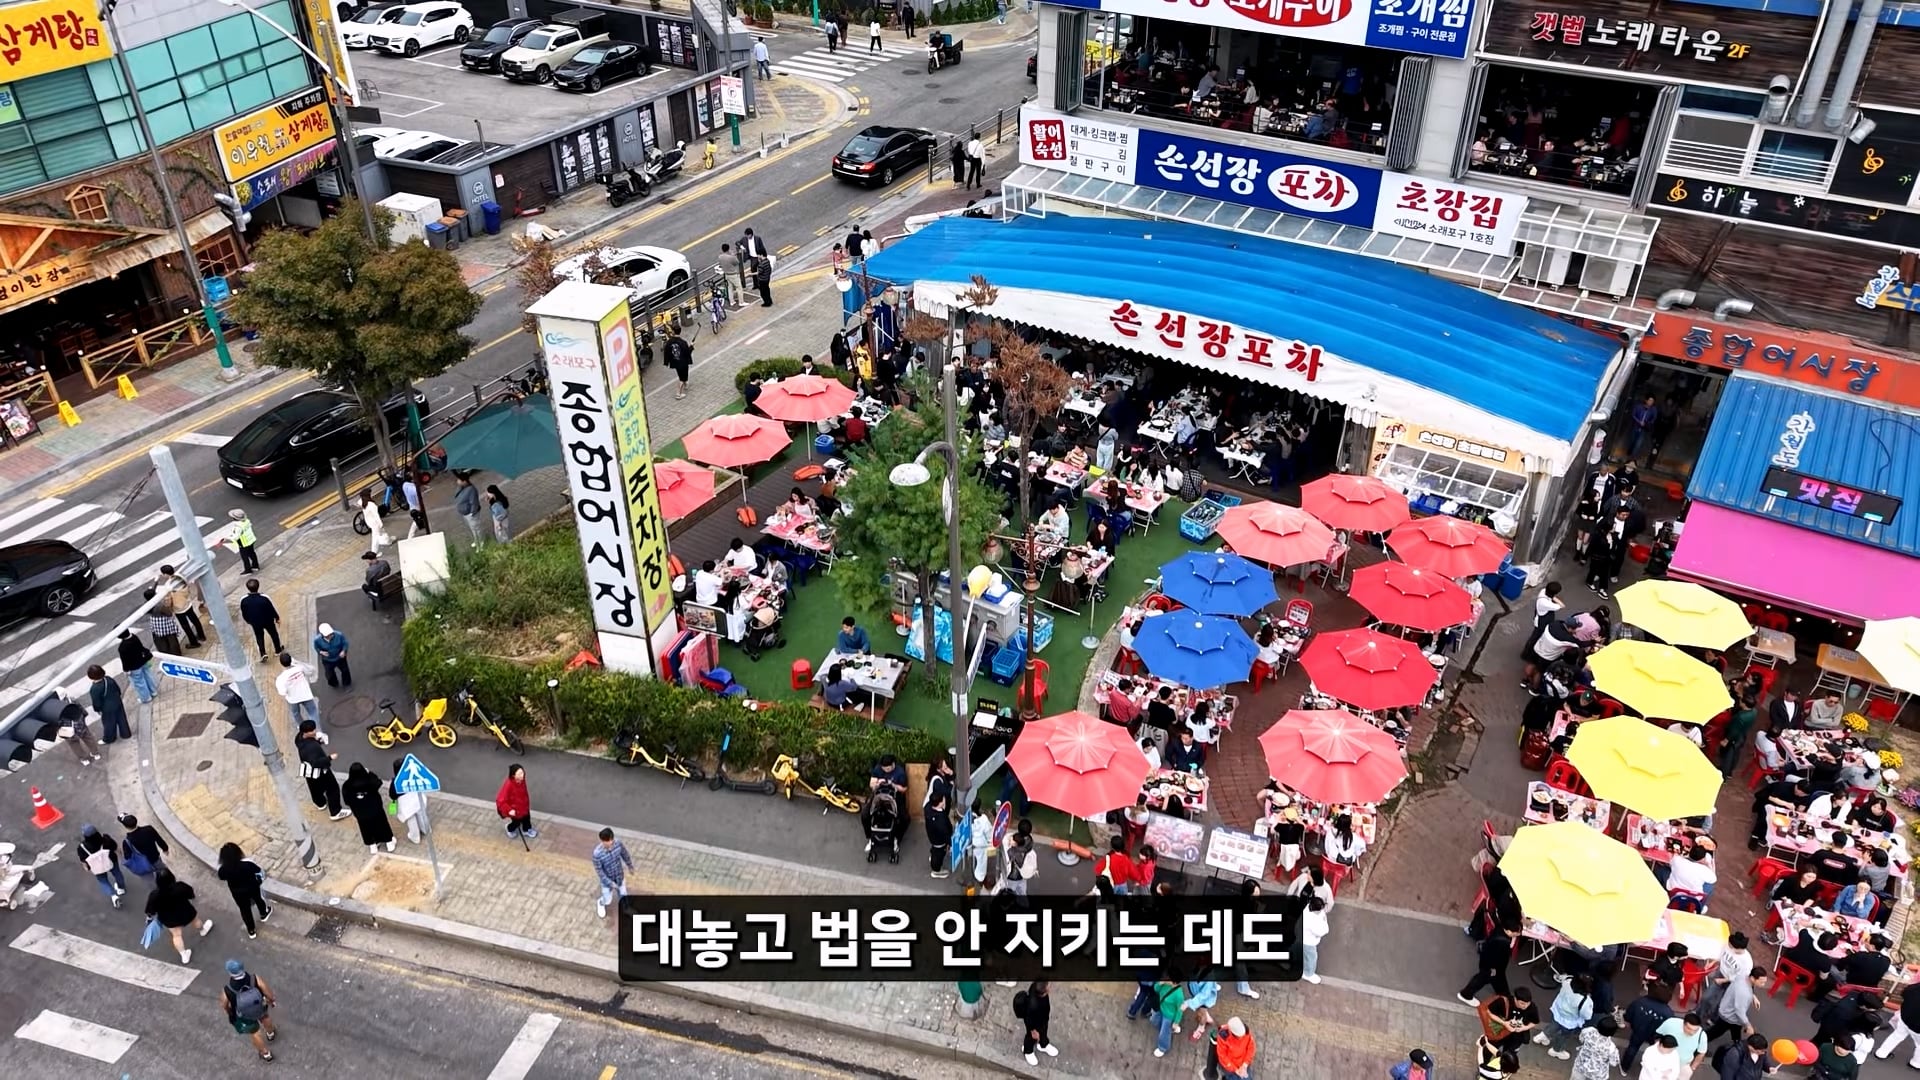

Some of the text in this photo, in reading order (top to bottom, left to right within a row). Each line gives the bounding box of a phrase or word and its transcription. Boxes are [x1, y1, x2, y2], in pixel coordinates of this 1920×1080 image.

[0, 10, 84, 66] 삼계탕
[1411, 27, 1428, 39] 구이
[1430, 30, 1457, 43] 전문점
[1531, 12, 1724, 62] 갯벌 노래타운
[1727, 43, 1751, 59] 2F
[288, 110, 324, 142] 삼계탕
[1032, 123, 1062, 141] 활어
[1034, 141, 1063, 159] 숙성
[1153, 144, 1351, 208] 손선장 포차
[1396, 181, 1504, 230] 초장집
[1702, 186, 1759, 215] 하늘
[1469, 231, 1496, 246] 1호점
[551, 354, 597, 372] 소래포구
[1682, 326, 1881, 393] 종합어시장
[558, 381, 636, 628] 종합어시장
[1798, 478, 1863, 514] 맛집
[629, 463, 663, 590] 주차장
